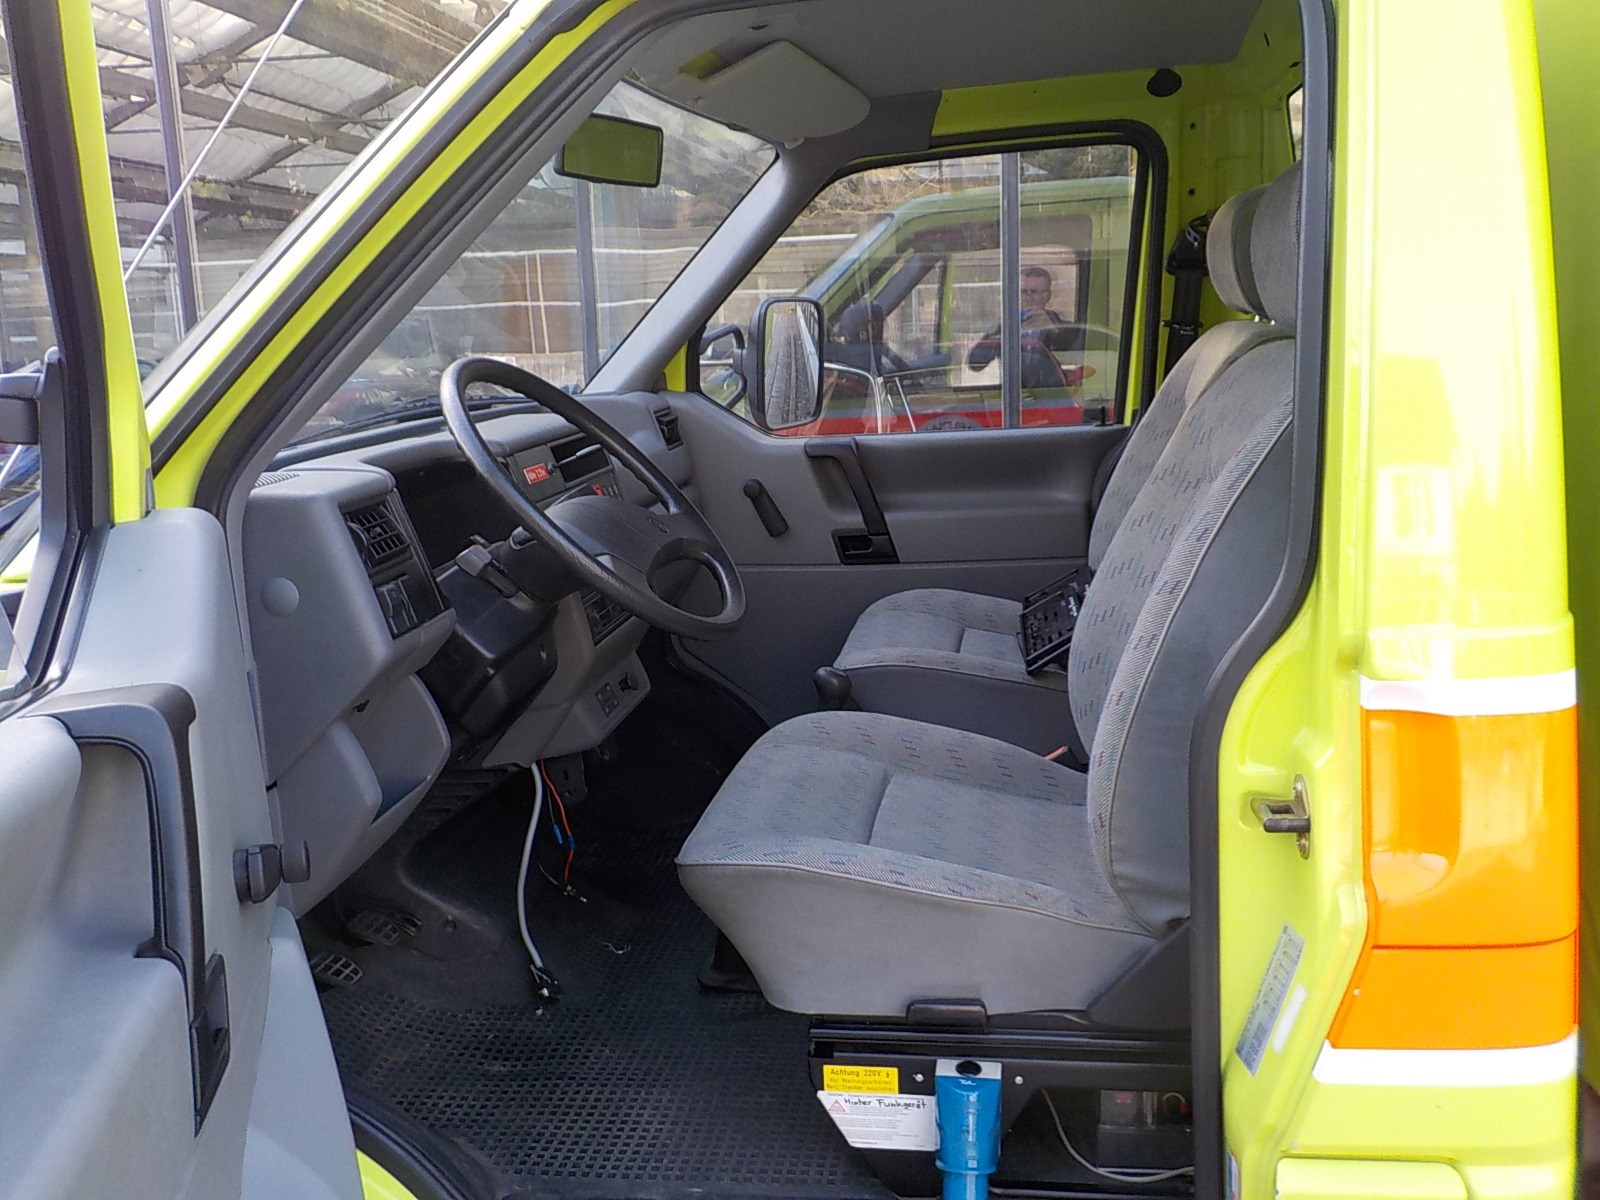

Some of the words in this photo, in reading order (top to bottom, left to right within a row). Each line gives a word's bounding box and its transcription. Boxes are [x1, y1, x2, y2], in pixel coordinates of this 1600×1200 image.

[830, 1068, 860, 1078] Achtung
[864, 1069, 881, 1077] 220V
[844, 1098, 872, 1106] Hinter
[876, 1098, 926, 1110] Funkgerät
